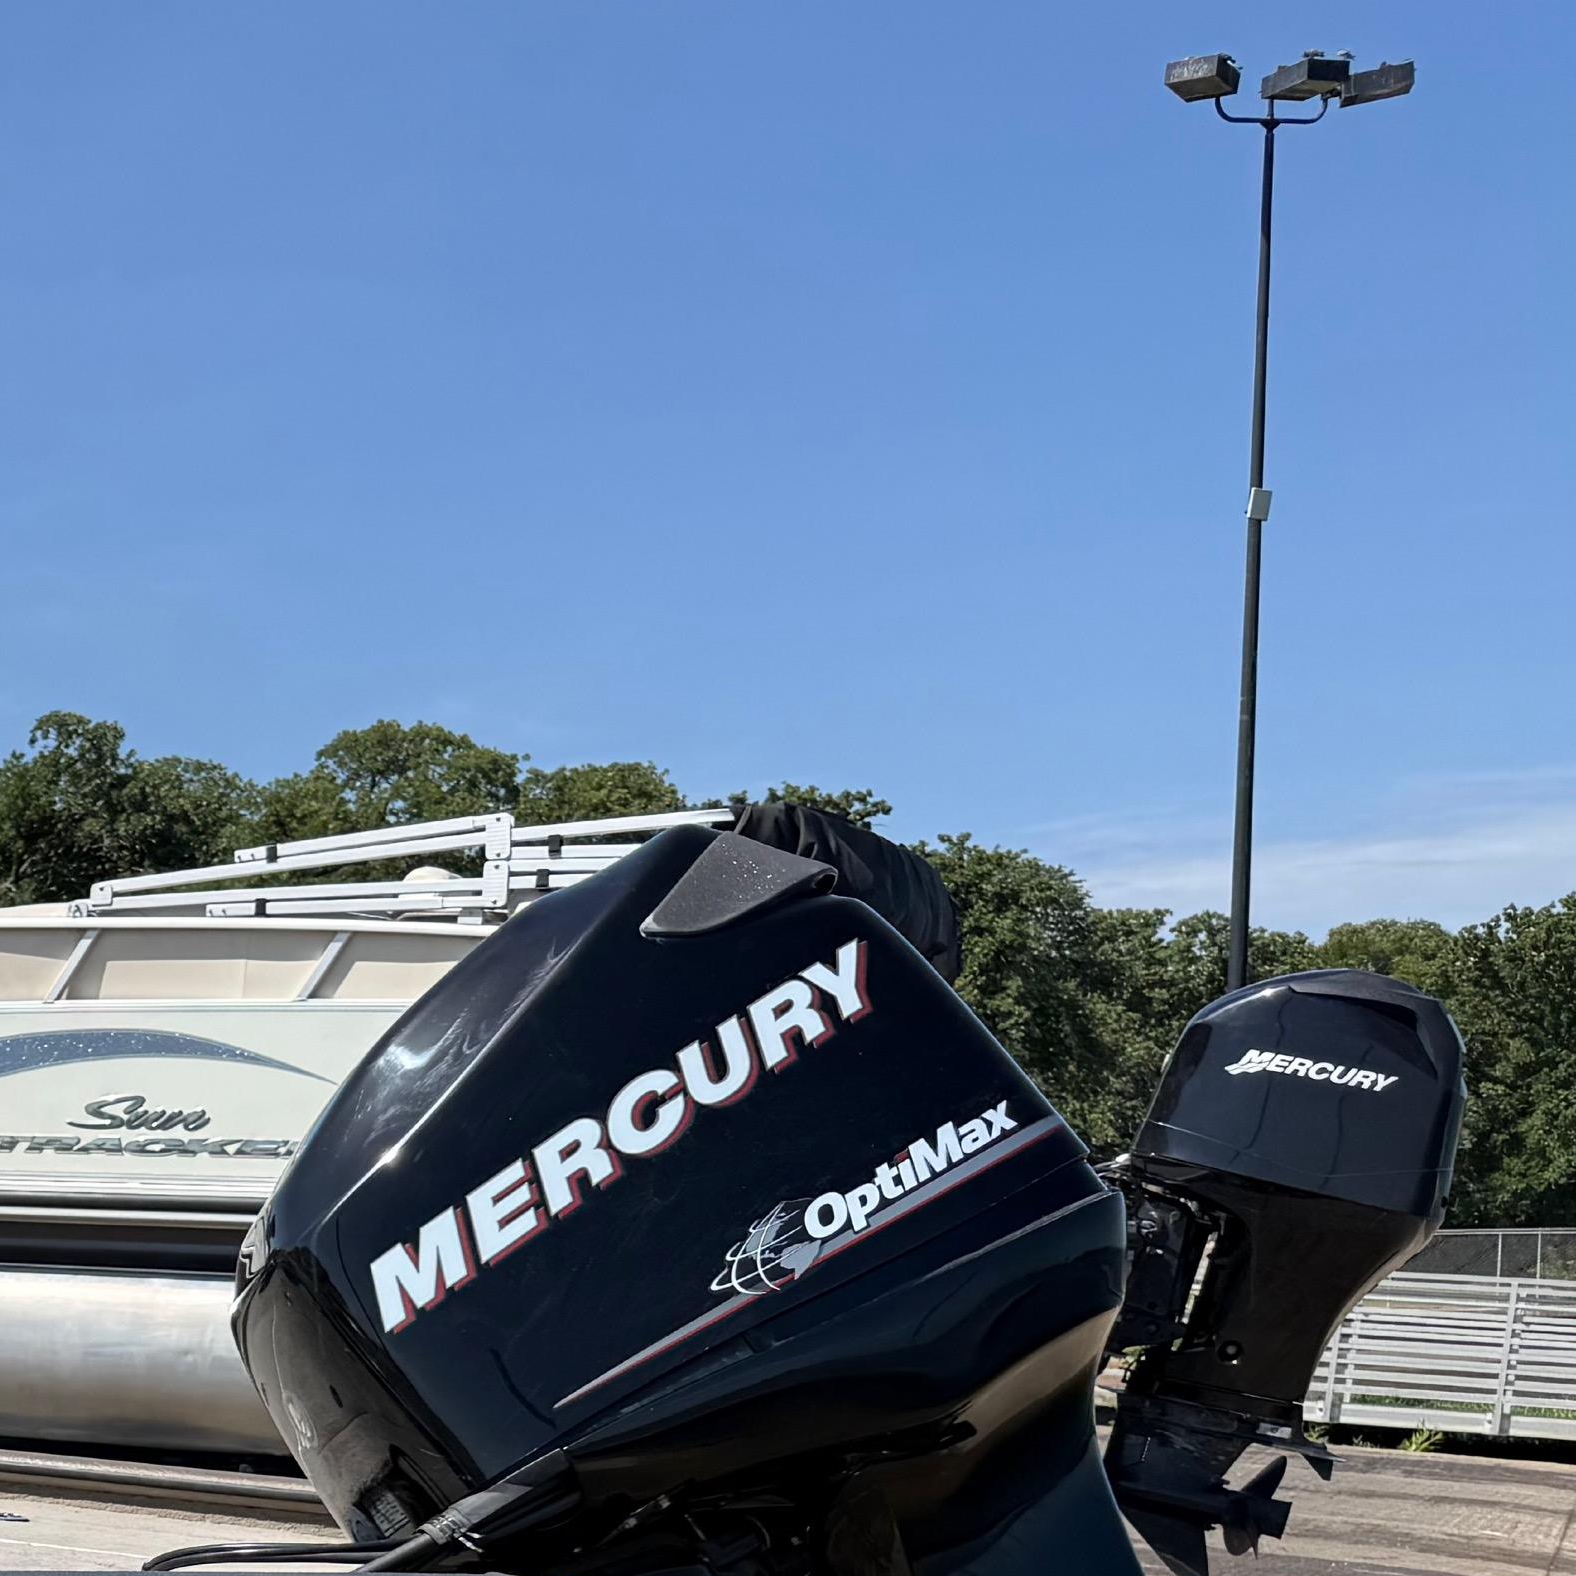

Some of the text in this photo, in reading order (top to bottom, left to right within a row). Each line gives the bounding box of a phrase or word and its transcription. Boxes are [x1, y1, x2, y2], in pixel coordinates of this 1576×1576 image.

[66, 1095, 211, 1132] Sun
[1224, 1048, 1399, 1092] MERCURY
[370, 938, 873, 1334] MERCURY
[803, 1099, 1019, 1240] OptiMax
